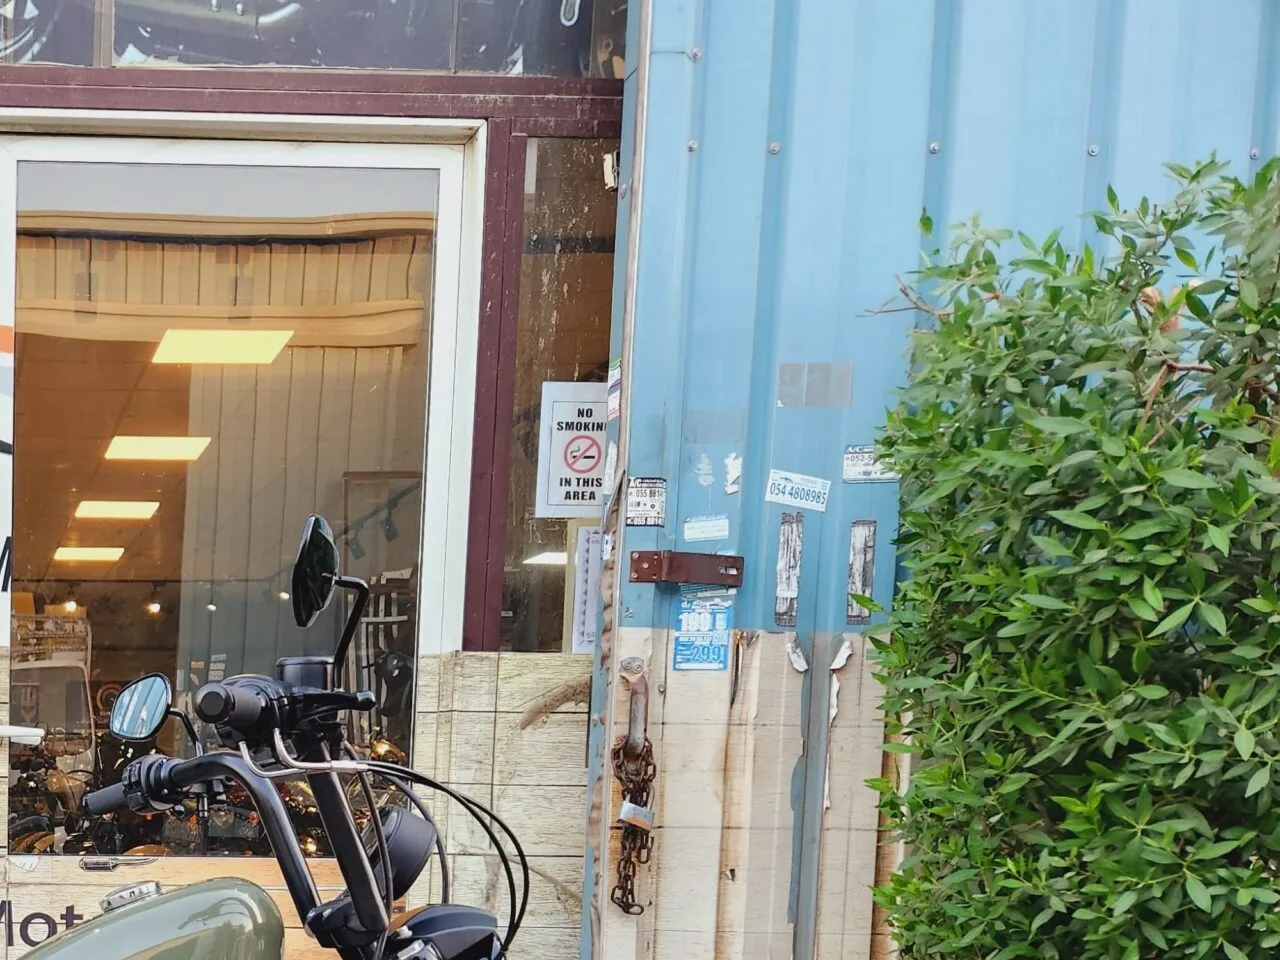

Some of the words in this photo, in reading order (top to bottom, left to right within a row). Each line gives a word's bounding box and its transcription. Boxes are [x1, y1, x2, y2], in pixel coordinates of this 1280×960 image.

[577, 408, 593, 418] NO
[557, 421, 607, 432] SMOKIN
[559, 477, 571, 487] IN
[575, 477, 602, 488] THIS
[564, 490, 596, 500] AREA
[769, 482, 786, 497] 054
[788, 485, 827, 505] 4808985
